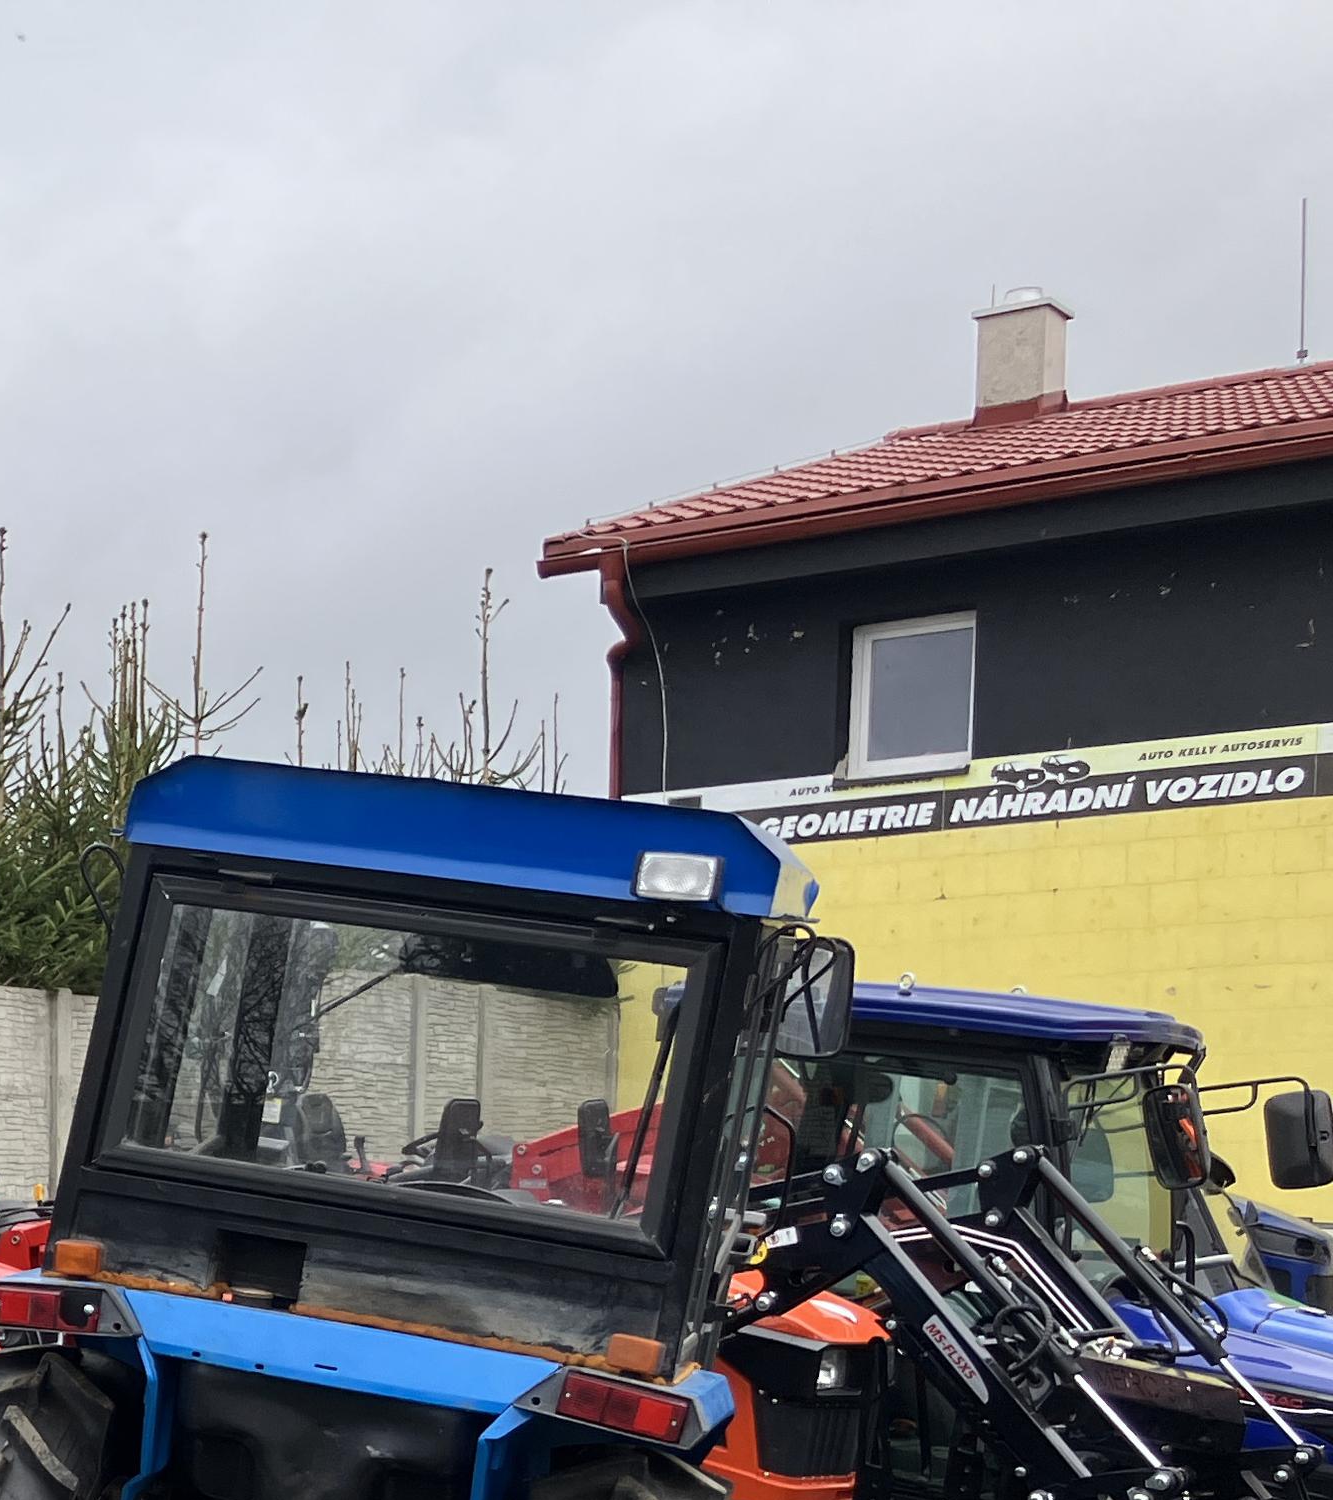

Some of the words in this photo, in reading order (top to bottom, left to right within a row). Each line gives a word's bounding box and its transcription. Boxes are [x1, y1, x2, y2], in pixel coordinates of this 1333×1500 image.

[1138, 750, 1174, 762] AUTO
[1178, 745, 1216, 757] KELLY
[1220, 736, 1303, 753] AUTOSERVIS
[759, 801, 936, 839] GEOMETRIE
[949, 776, 1136, 823] NÁHRADNÍ
[1145, 767, 1305, 805] VOZIDLO
[789, 786, 820, 797] AUTO
